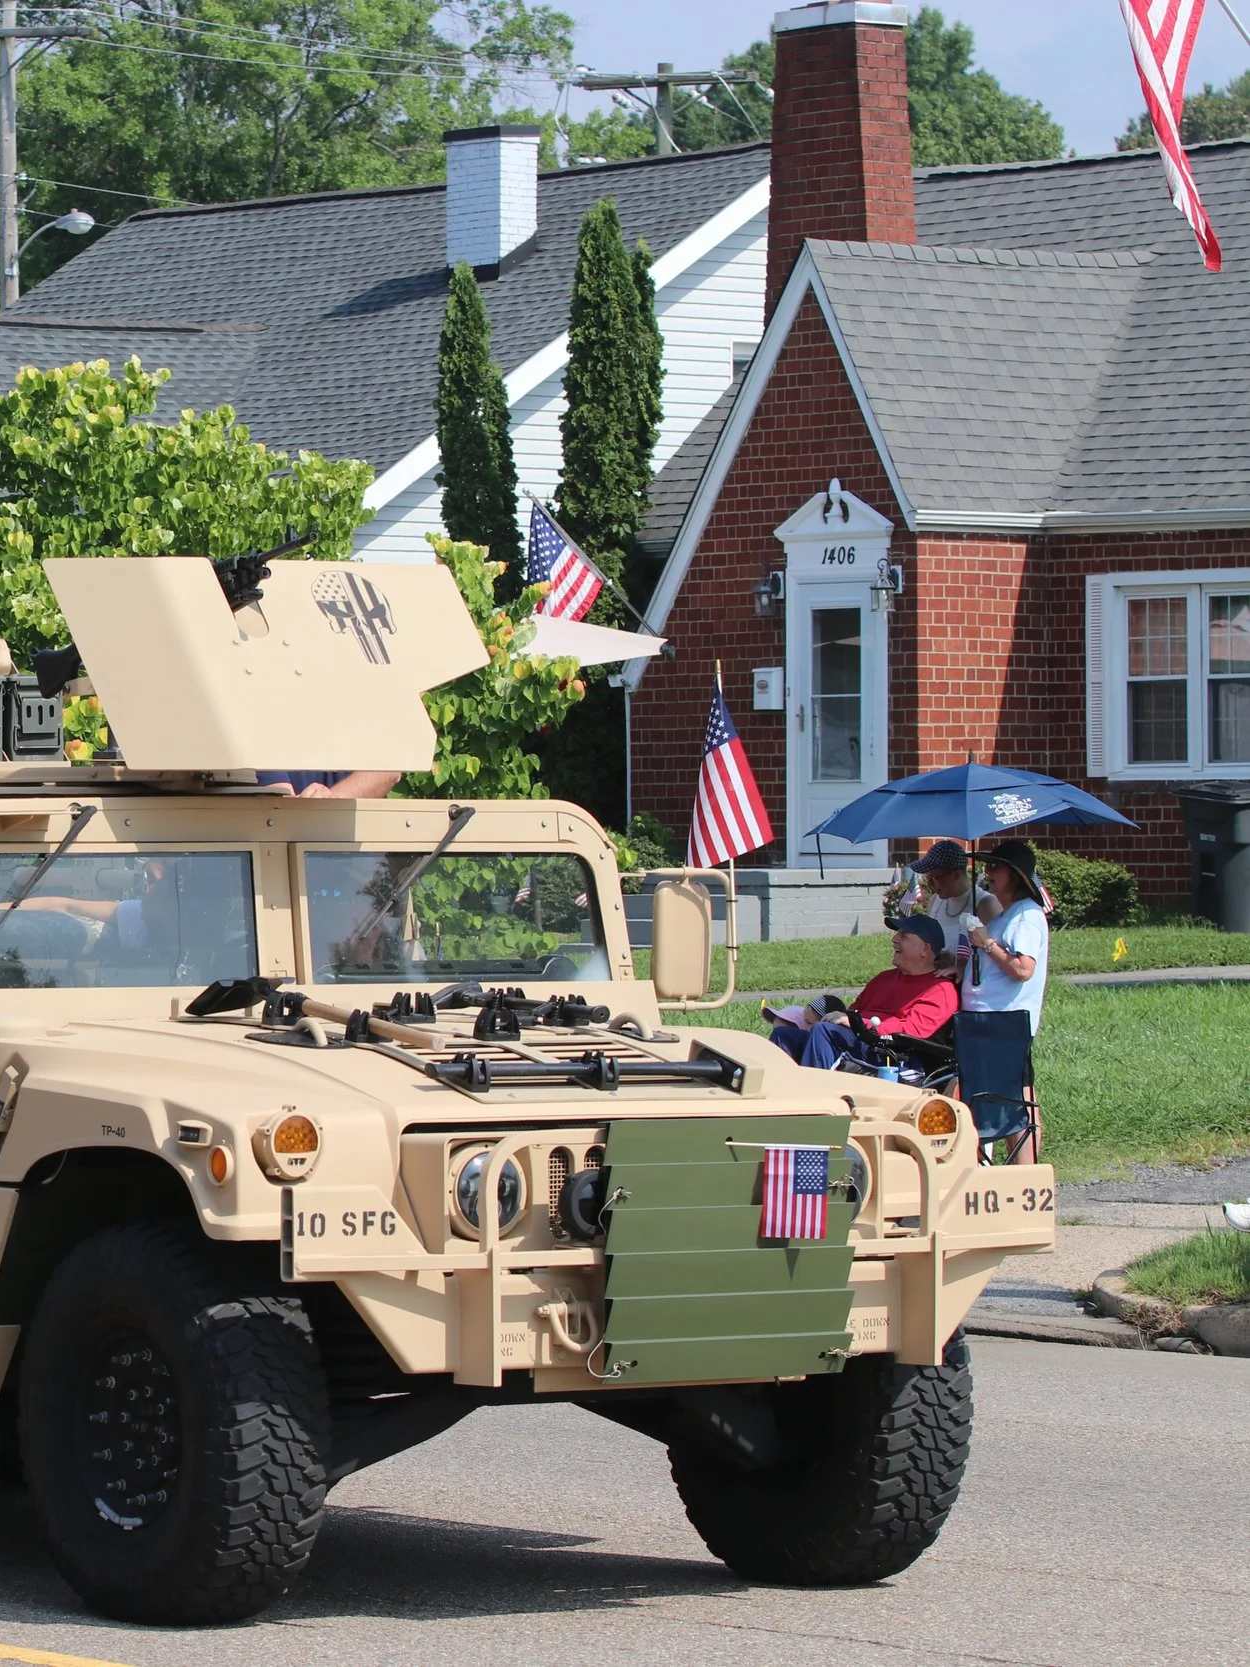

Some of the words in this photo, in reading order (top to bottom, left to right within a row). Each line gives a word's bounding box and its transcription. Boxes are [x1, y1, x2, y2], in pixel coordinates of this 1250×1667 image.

[821, 546, 855, 565] 1406
[101, 1124, 126, 1138] TP-40
[297, 1211, 326, 1238] 10
[342, 1211, 396, 1236] SFG
